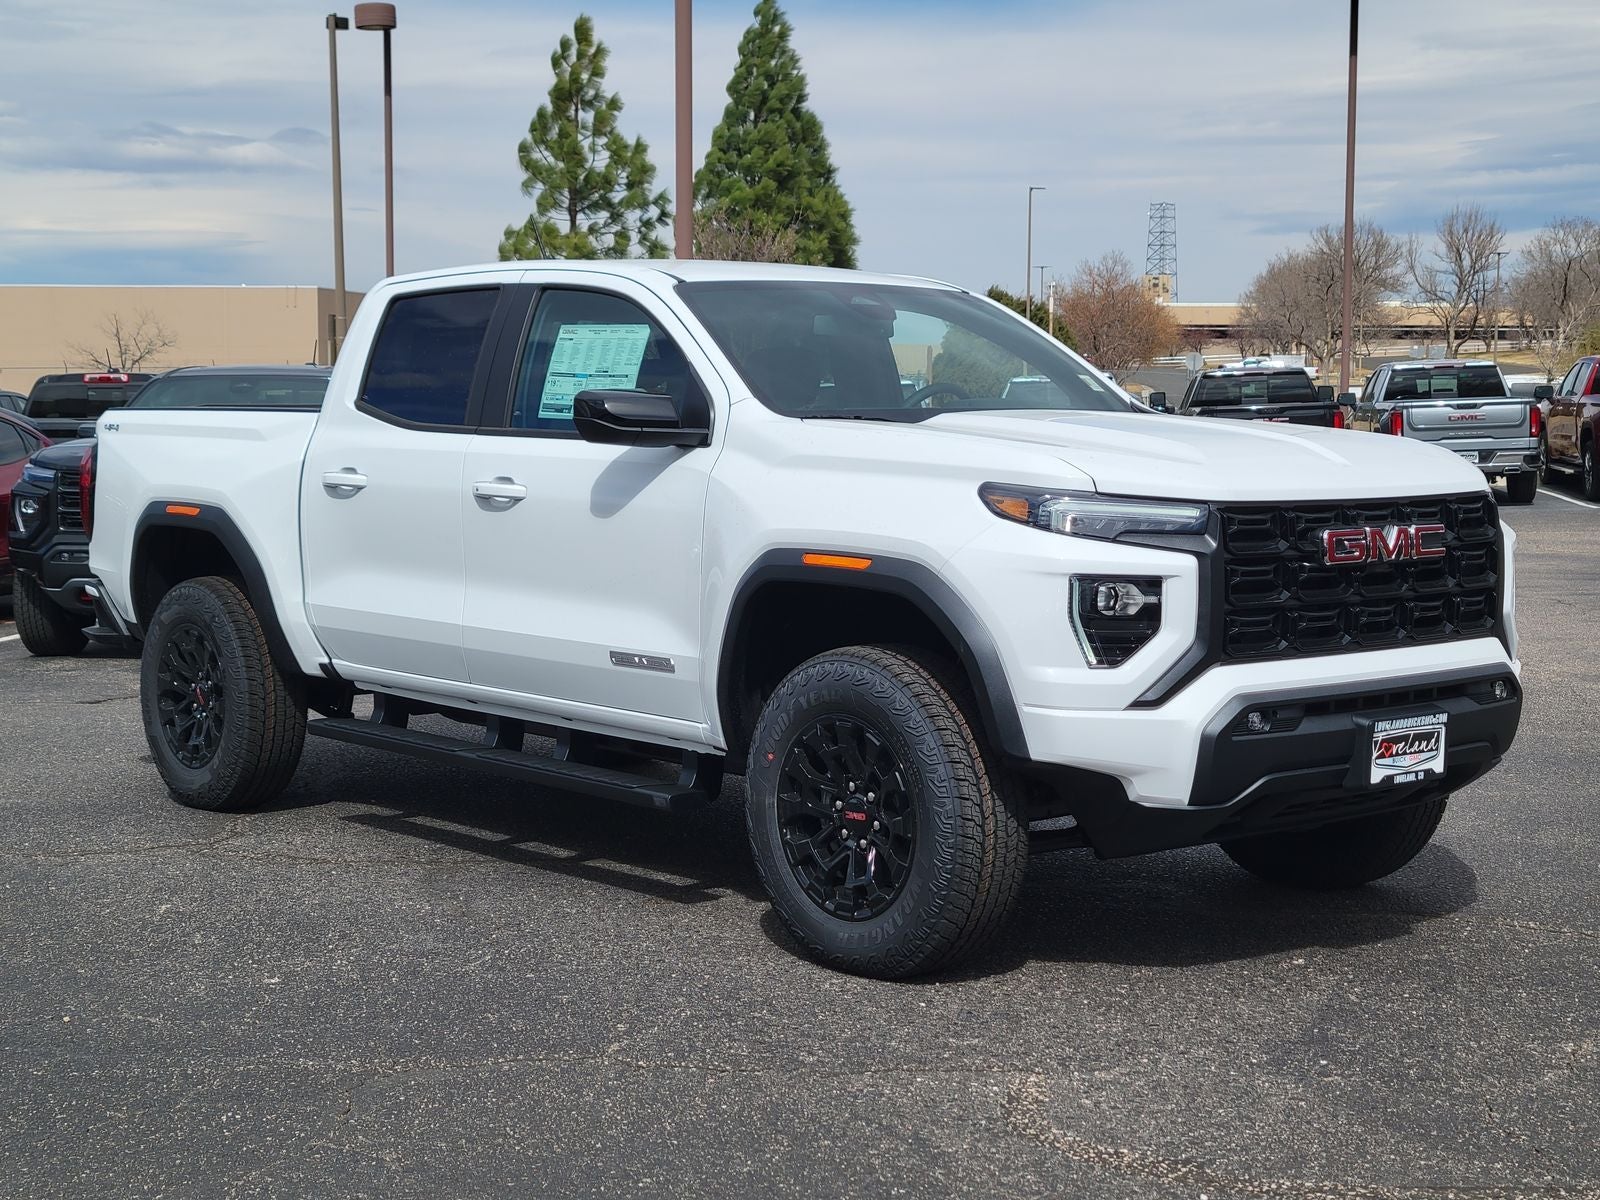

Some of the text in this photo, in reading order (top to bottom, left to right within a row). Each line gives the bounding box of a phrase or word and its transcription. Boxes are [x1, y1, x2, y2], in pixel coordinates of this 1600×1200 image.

[1448, 412, 1487, 422] GMC
[1322, 523, 1447, 566] GMC
[1374, 713, 1448, 732] LOVELANDBUICKGMC.COM
[1372, 731, 1439, 760] Loveland
[1392, 754, 1422, 764] BUICK GMC
[1417, 771, 1425, 780] CO
